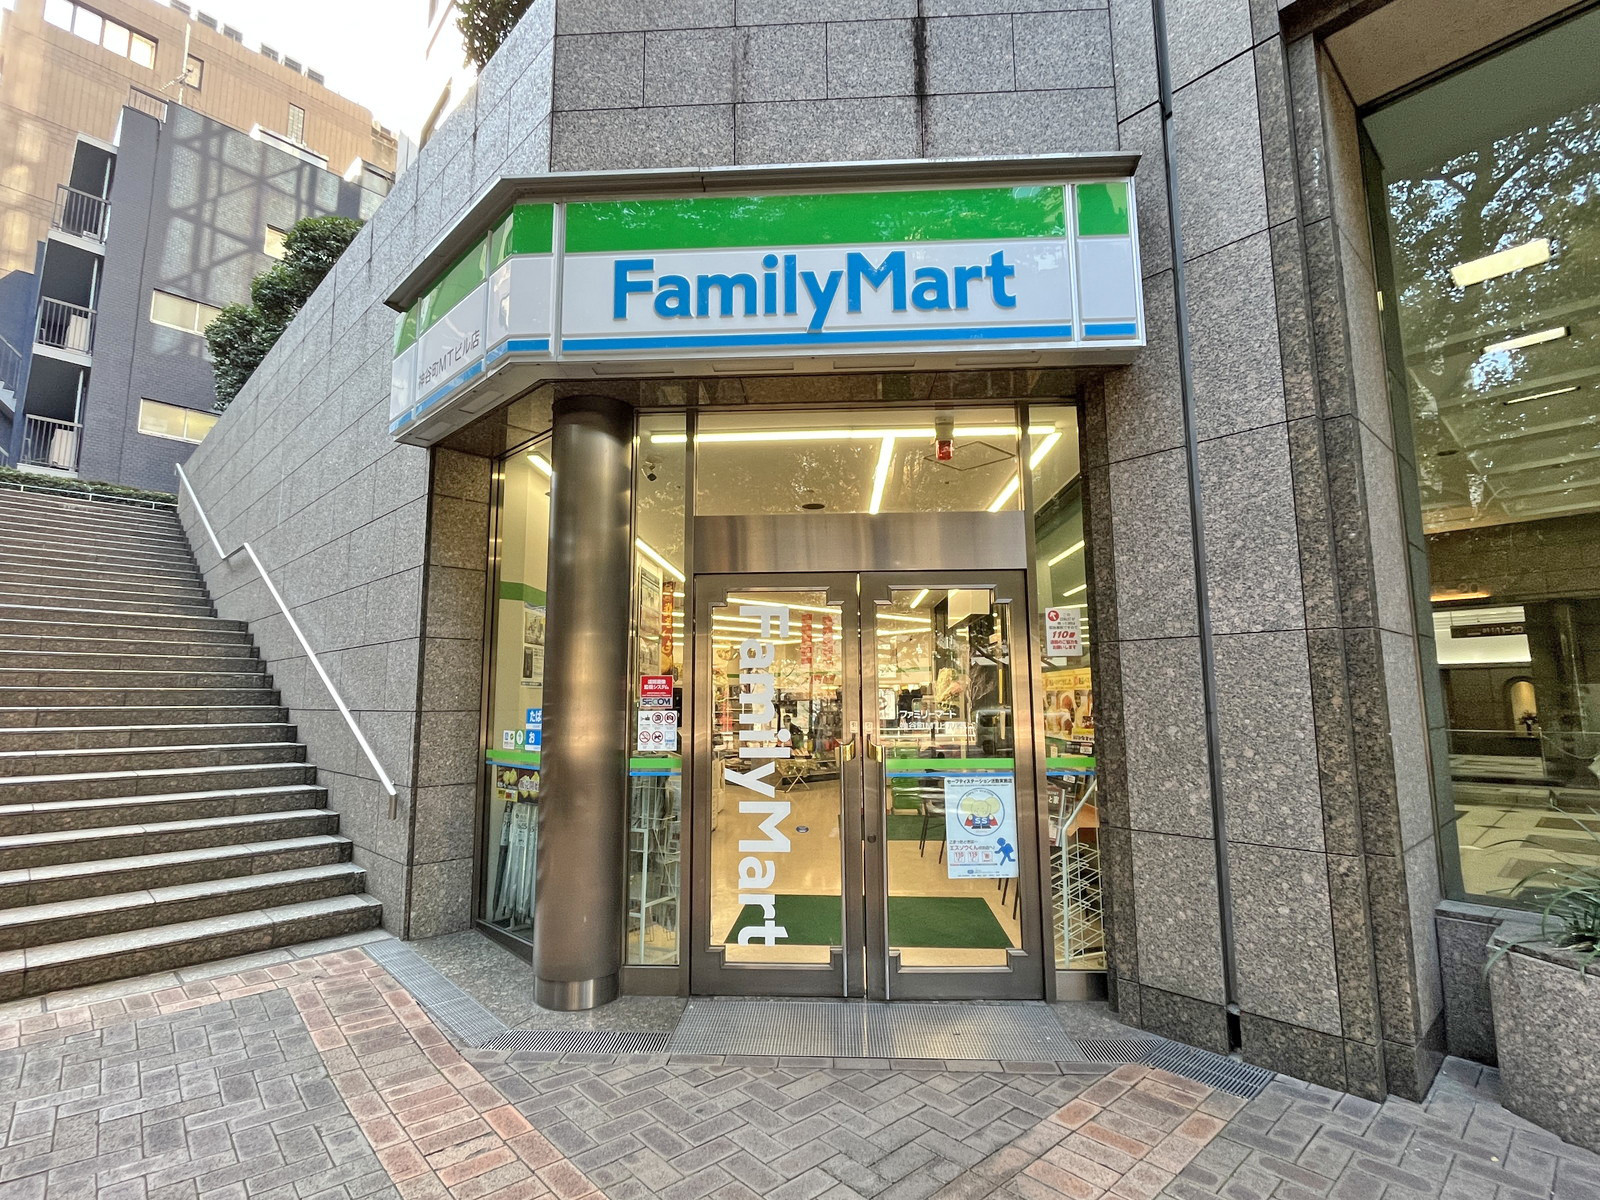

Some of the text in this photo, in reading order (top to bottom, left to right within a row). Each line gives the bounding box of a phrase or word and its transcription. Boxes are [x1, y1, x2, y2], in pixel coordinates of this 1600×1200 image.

[613, 249, 1017, 333] FamilyMart
[1052, 630, 1076, 638] 110
[899, 710, 957, 719] ファミリーマート
[724, 606, 791, 946] FamilyMart
